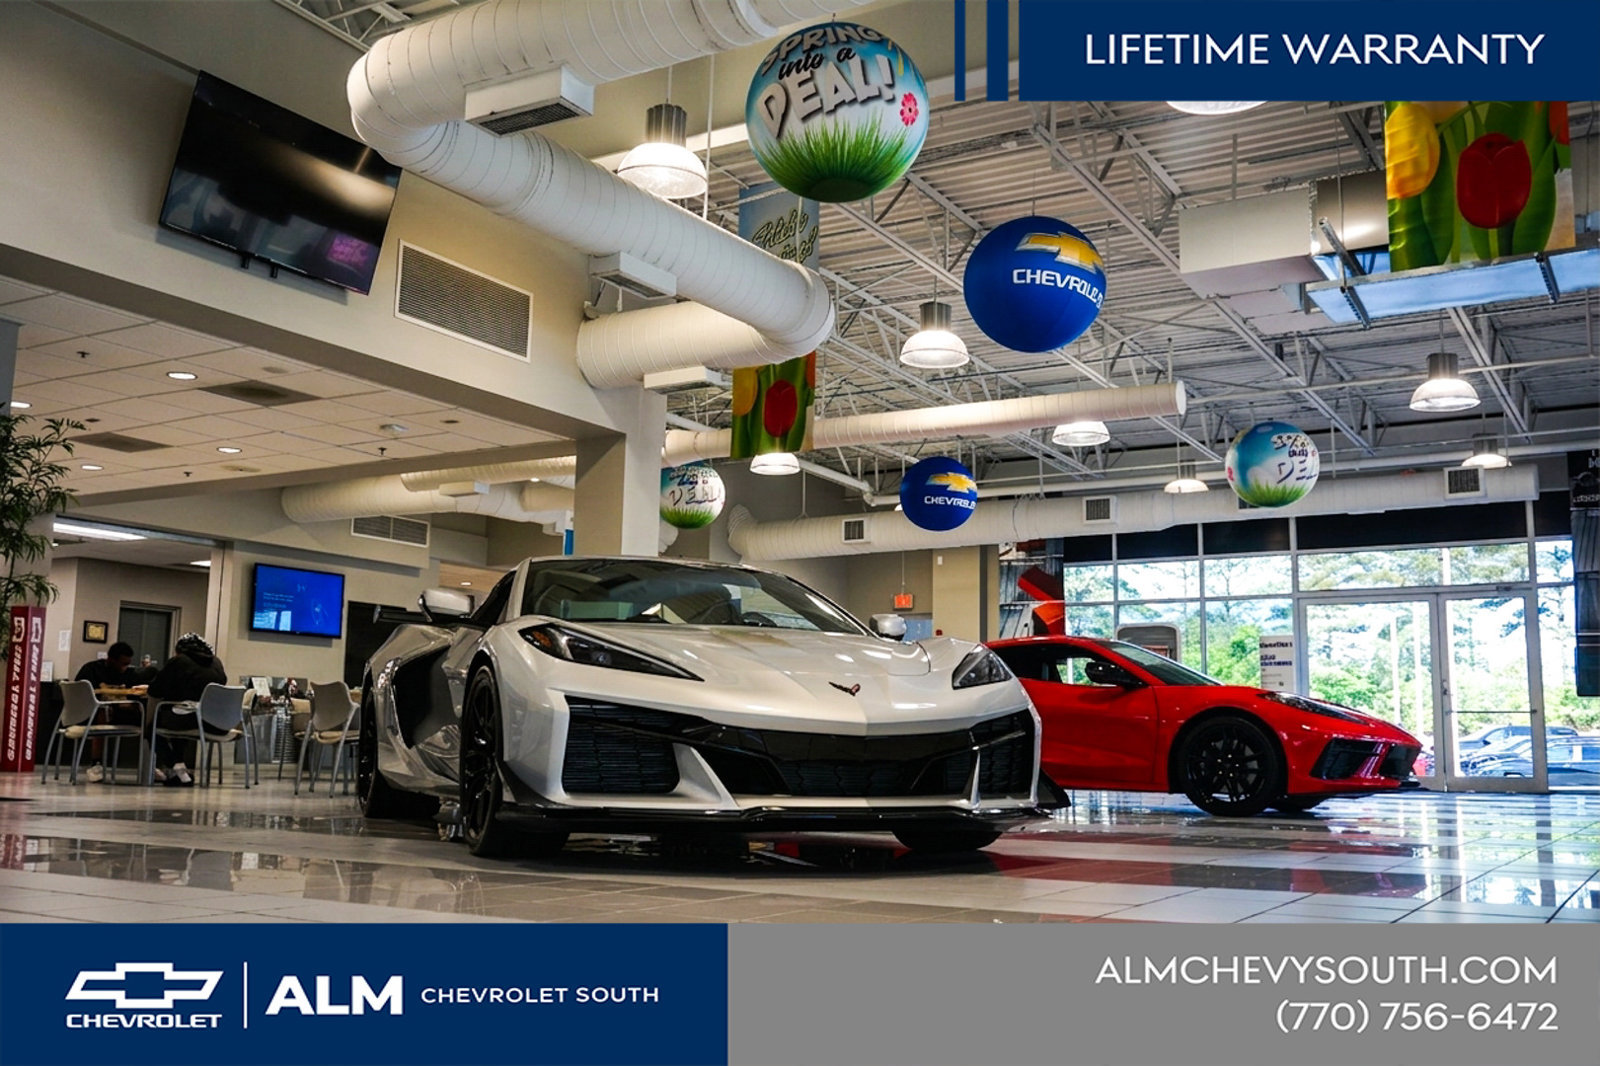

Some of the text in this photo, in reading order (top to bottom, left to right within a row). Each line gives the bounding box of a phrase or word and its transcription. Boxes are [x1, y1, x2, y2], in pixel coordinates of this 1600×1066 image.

[778, 47, 857, 80] into a
[757, 54, 896, 139] DEAL!
